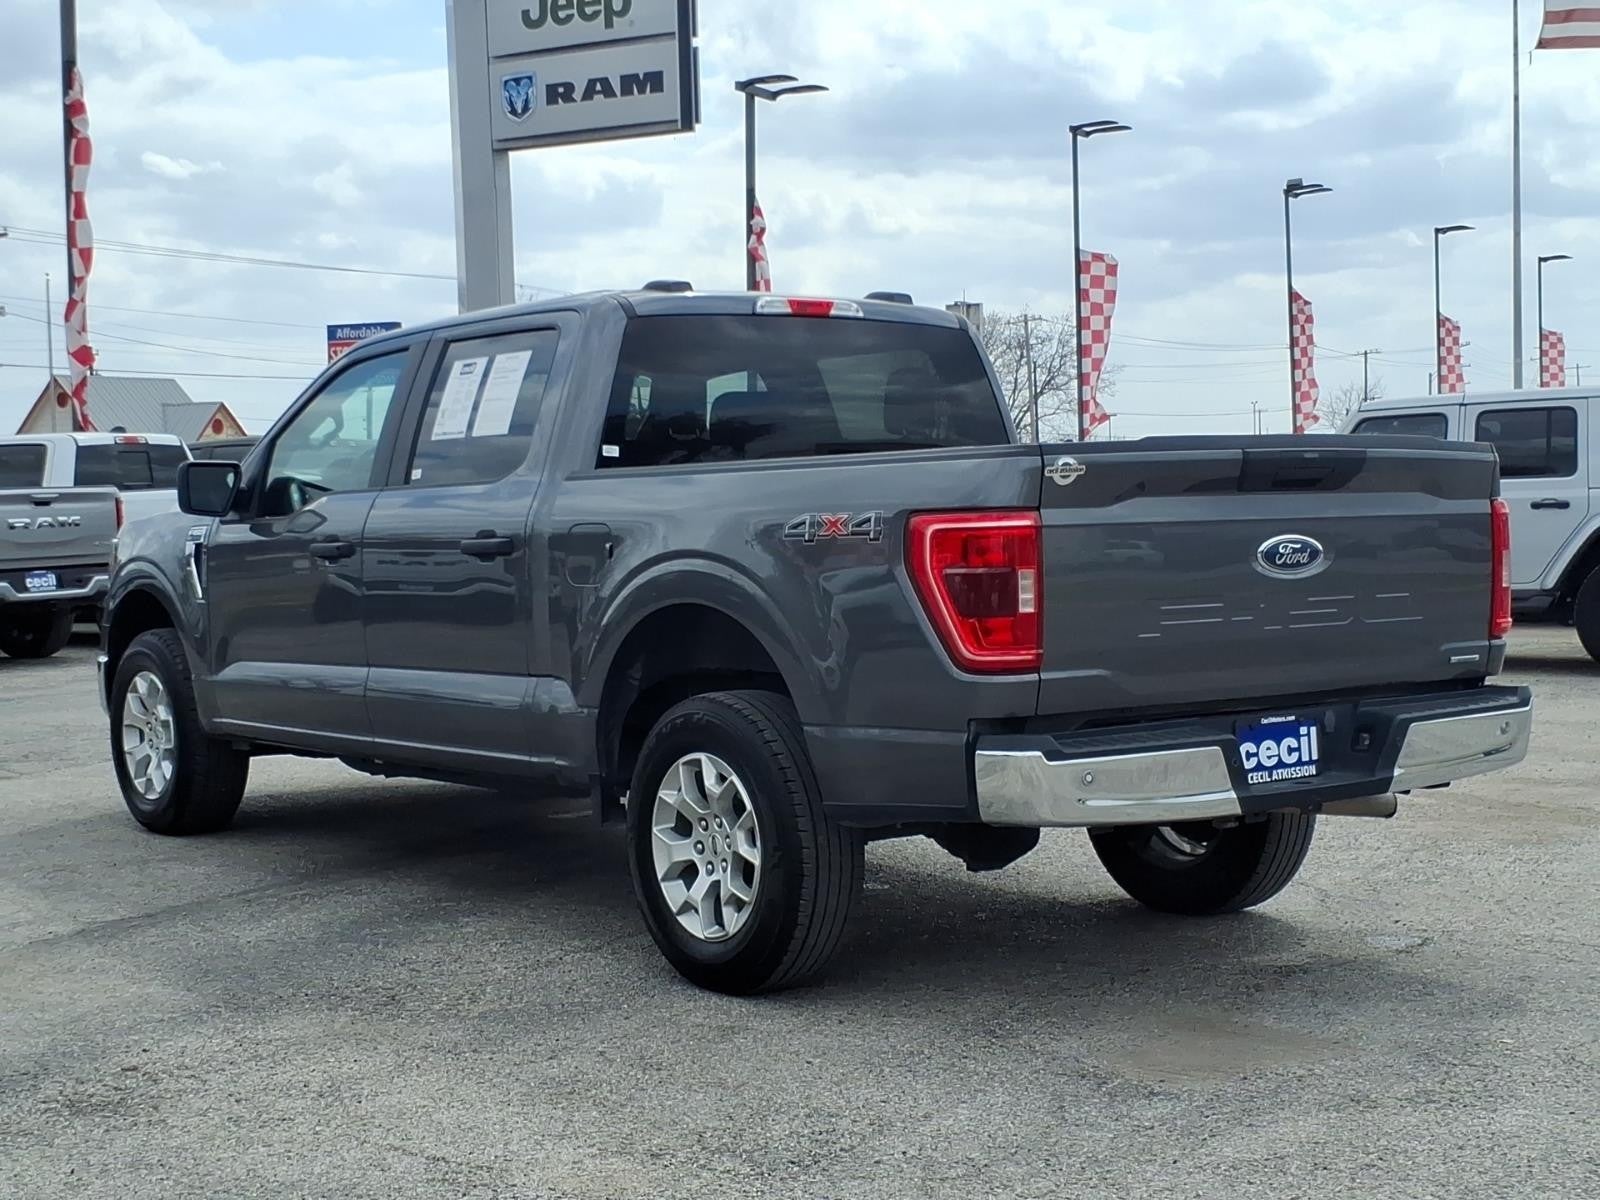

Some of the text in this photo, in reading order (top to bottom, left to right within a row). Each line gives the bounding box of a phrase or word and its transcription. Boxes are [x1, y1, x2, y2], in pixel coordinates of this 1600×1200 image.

[521, 0, 632, 30] Jeep
[545, 70, 665, 106] RAM
[8, 516, 81, 531] RAM
[1275, 543, 1311, 564] Ford
[1239, 726, 1319, 770] cecil
[1247, 764, 1317, 784] CECIL ATKISSION
